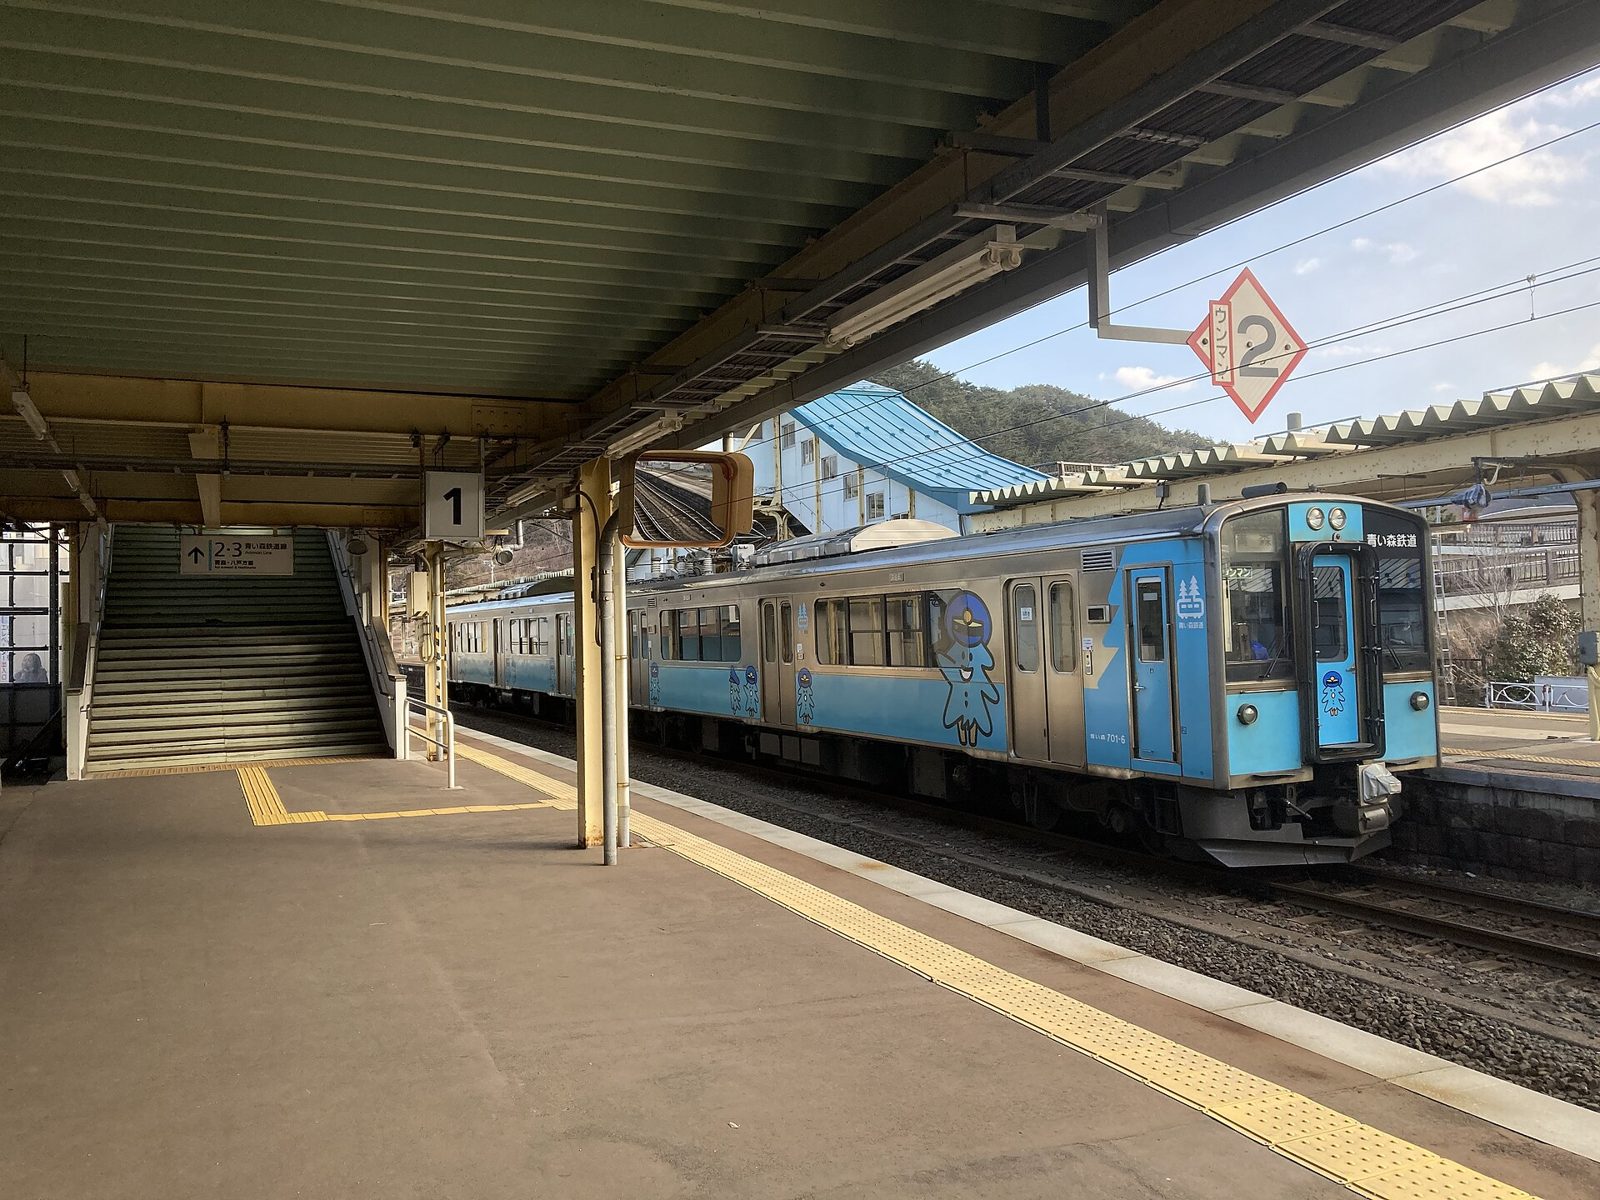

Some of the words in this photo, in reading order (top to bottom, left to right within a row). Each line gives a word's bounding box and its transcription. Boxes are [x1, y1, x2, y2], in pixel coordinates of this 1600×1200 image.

[1237, 314, 1279, 378] 2
[442, 487, 462, 526] 1
[1366, 533, 1418, 548] 青い森鉄道
